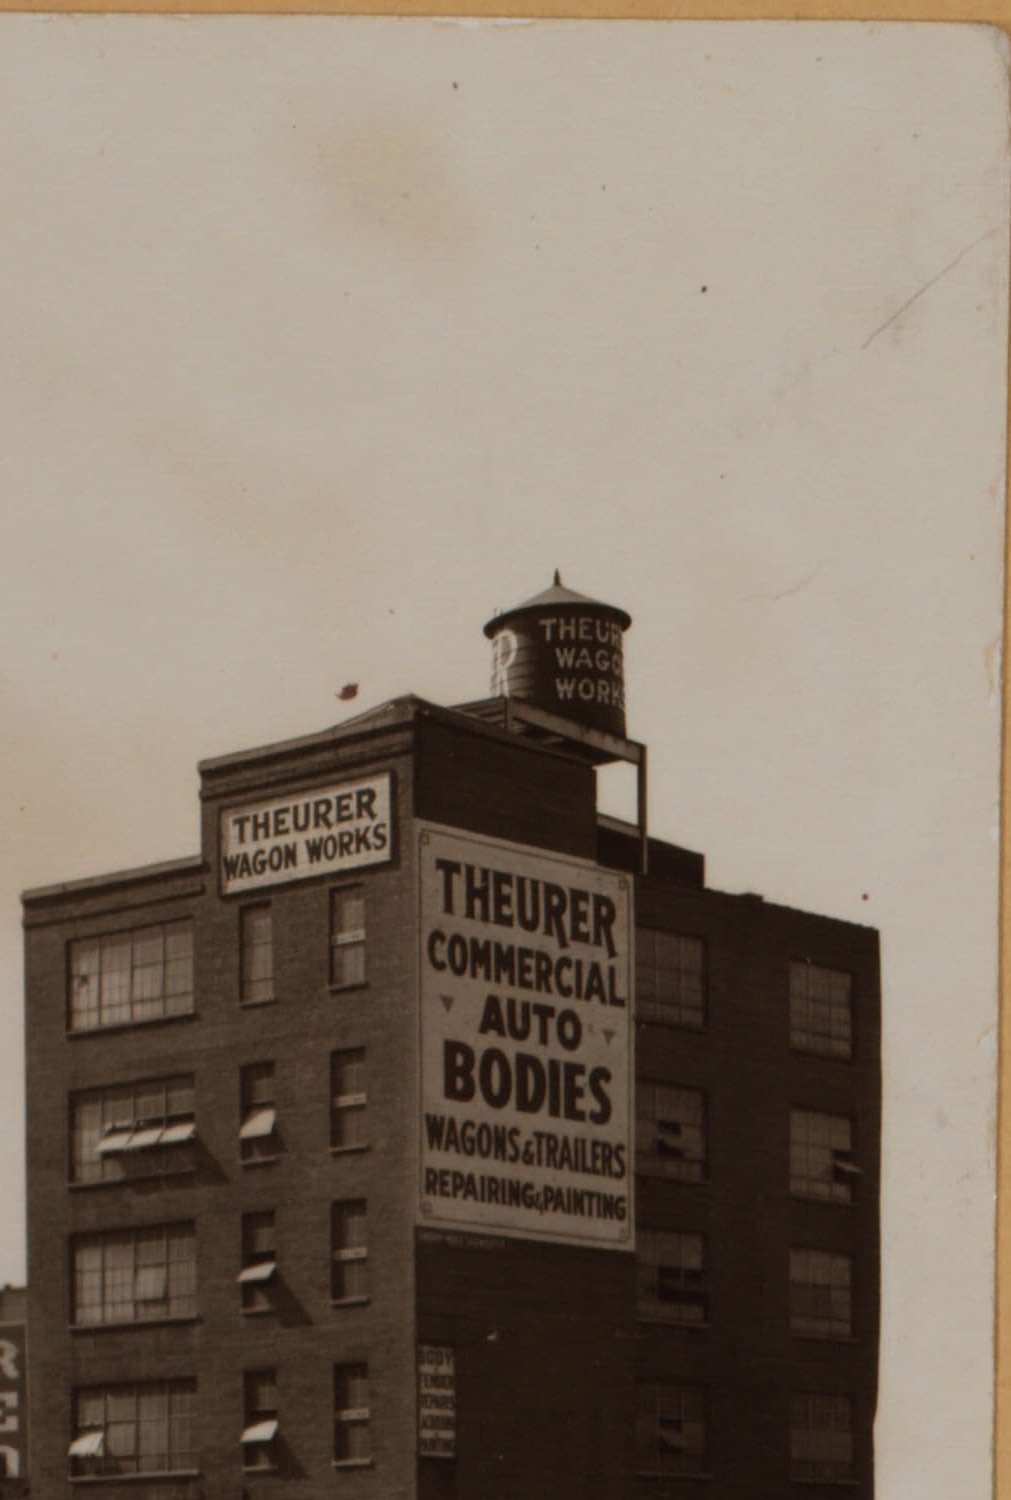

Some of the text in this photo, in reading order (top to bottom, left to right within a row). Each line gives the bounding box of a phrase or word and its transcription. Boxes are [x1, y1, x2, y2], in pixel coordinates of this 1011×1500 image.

[233, 787, 378, 845] THEURER
[222, 823, 388, 882] WAGON WORKS
[435, 857, 617, 958] THEURER
[427, 928, 625, 1007] COMMERCIAL
[478, 993, 583, 1052] AUTO
[443, 1037, 613, 1126] BODIES
